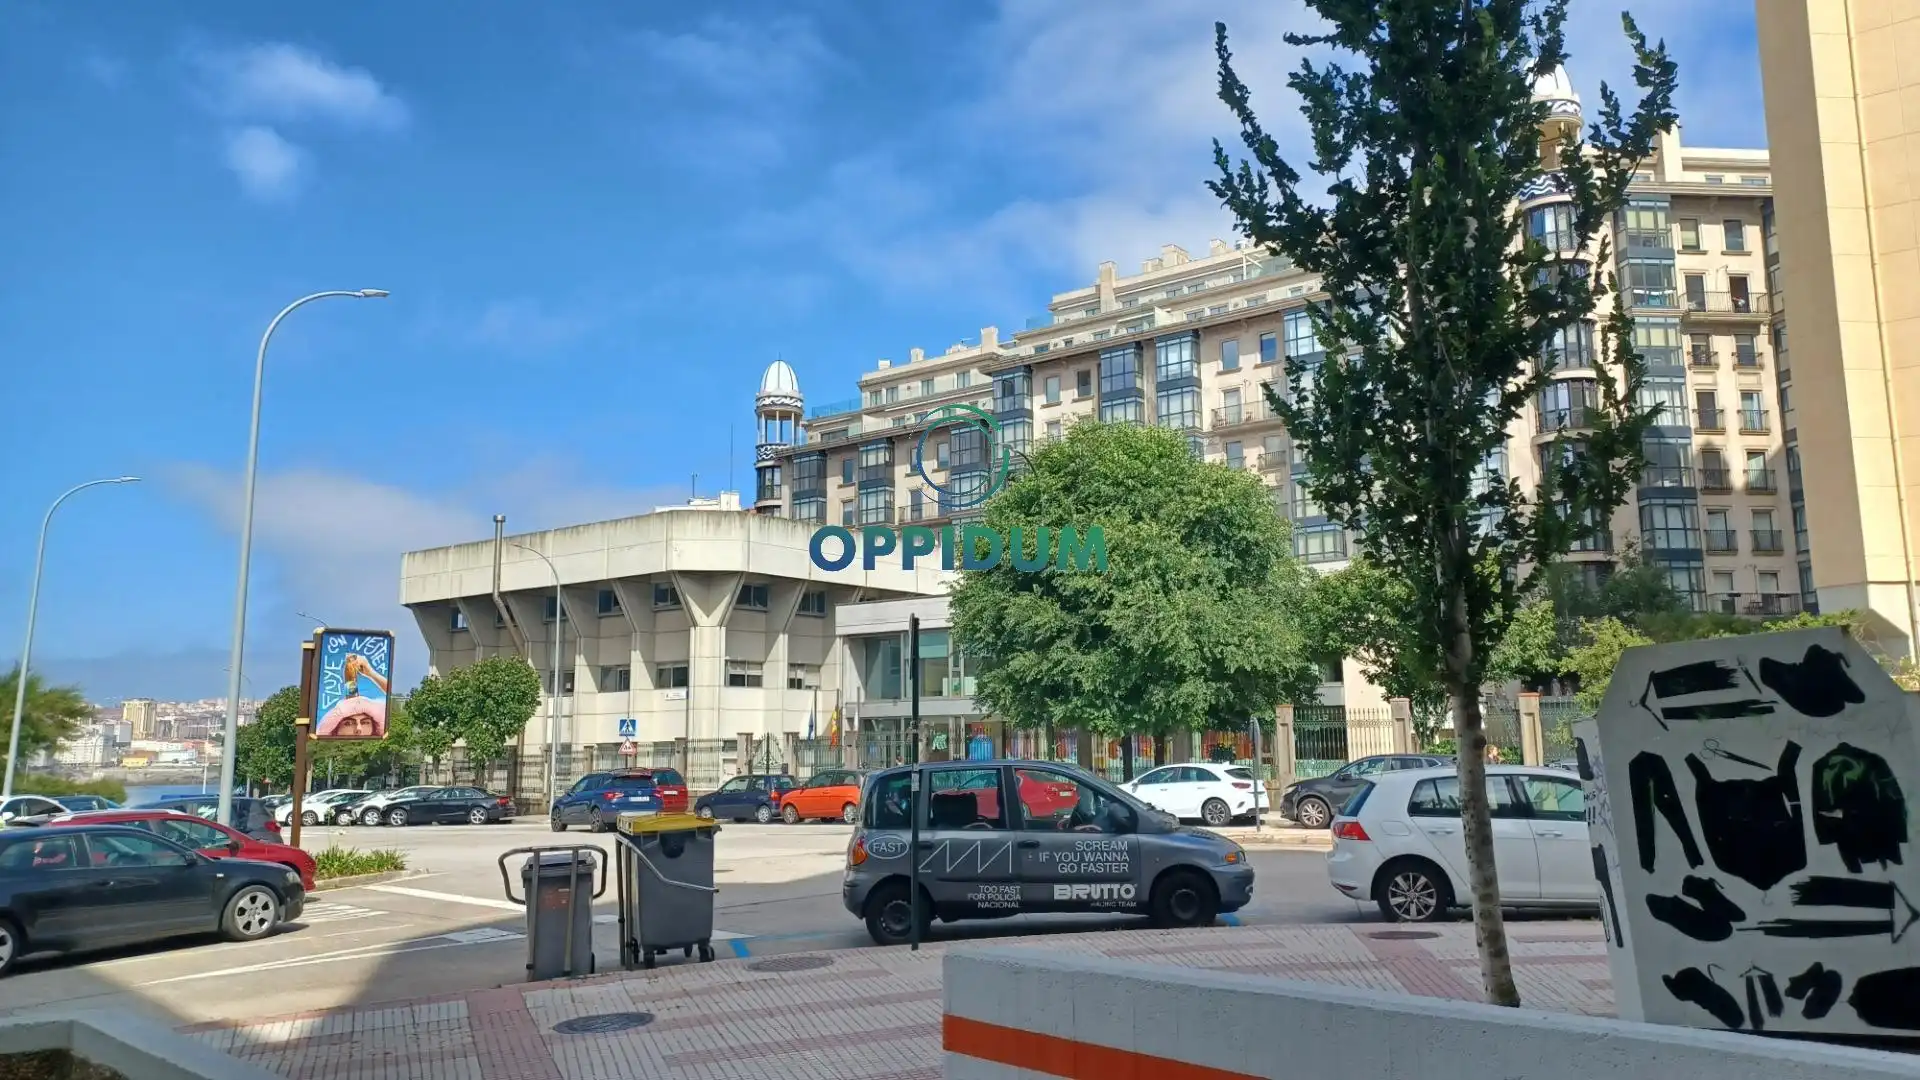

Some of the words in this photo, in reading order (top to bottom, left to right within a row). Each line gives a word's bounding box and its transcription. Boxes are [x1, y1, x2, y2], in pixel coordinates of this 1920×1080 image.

[327, 634, 348, 654] CON
[351, 636, 388, 674] NESTEA
[322, 655, 343, 709] FLUYE
[872, 842, 902, 852] FAST
[1075, 841, 1128, 851] SCREAM
[1039, 852, 1050, 862] IF
[1053, 852, 1080, 862] YOU
[1083, 852, 1130, 862] WANNA
[1058, 863, 1077, 873] GO
[1081, 863, 1129, 873] FASTER
[979, 885, 998, 893] TOO
[999, 885, 1021, 893] FAST
[1053, 884, 1136, 900] BRUTTO
